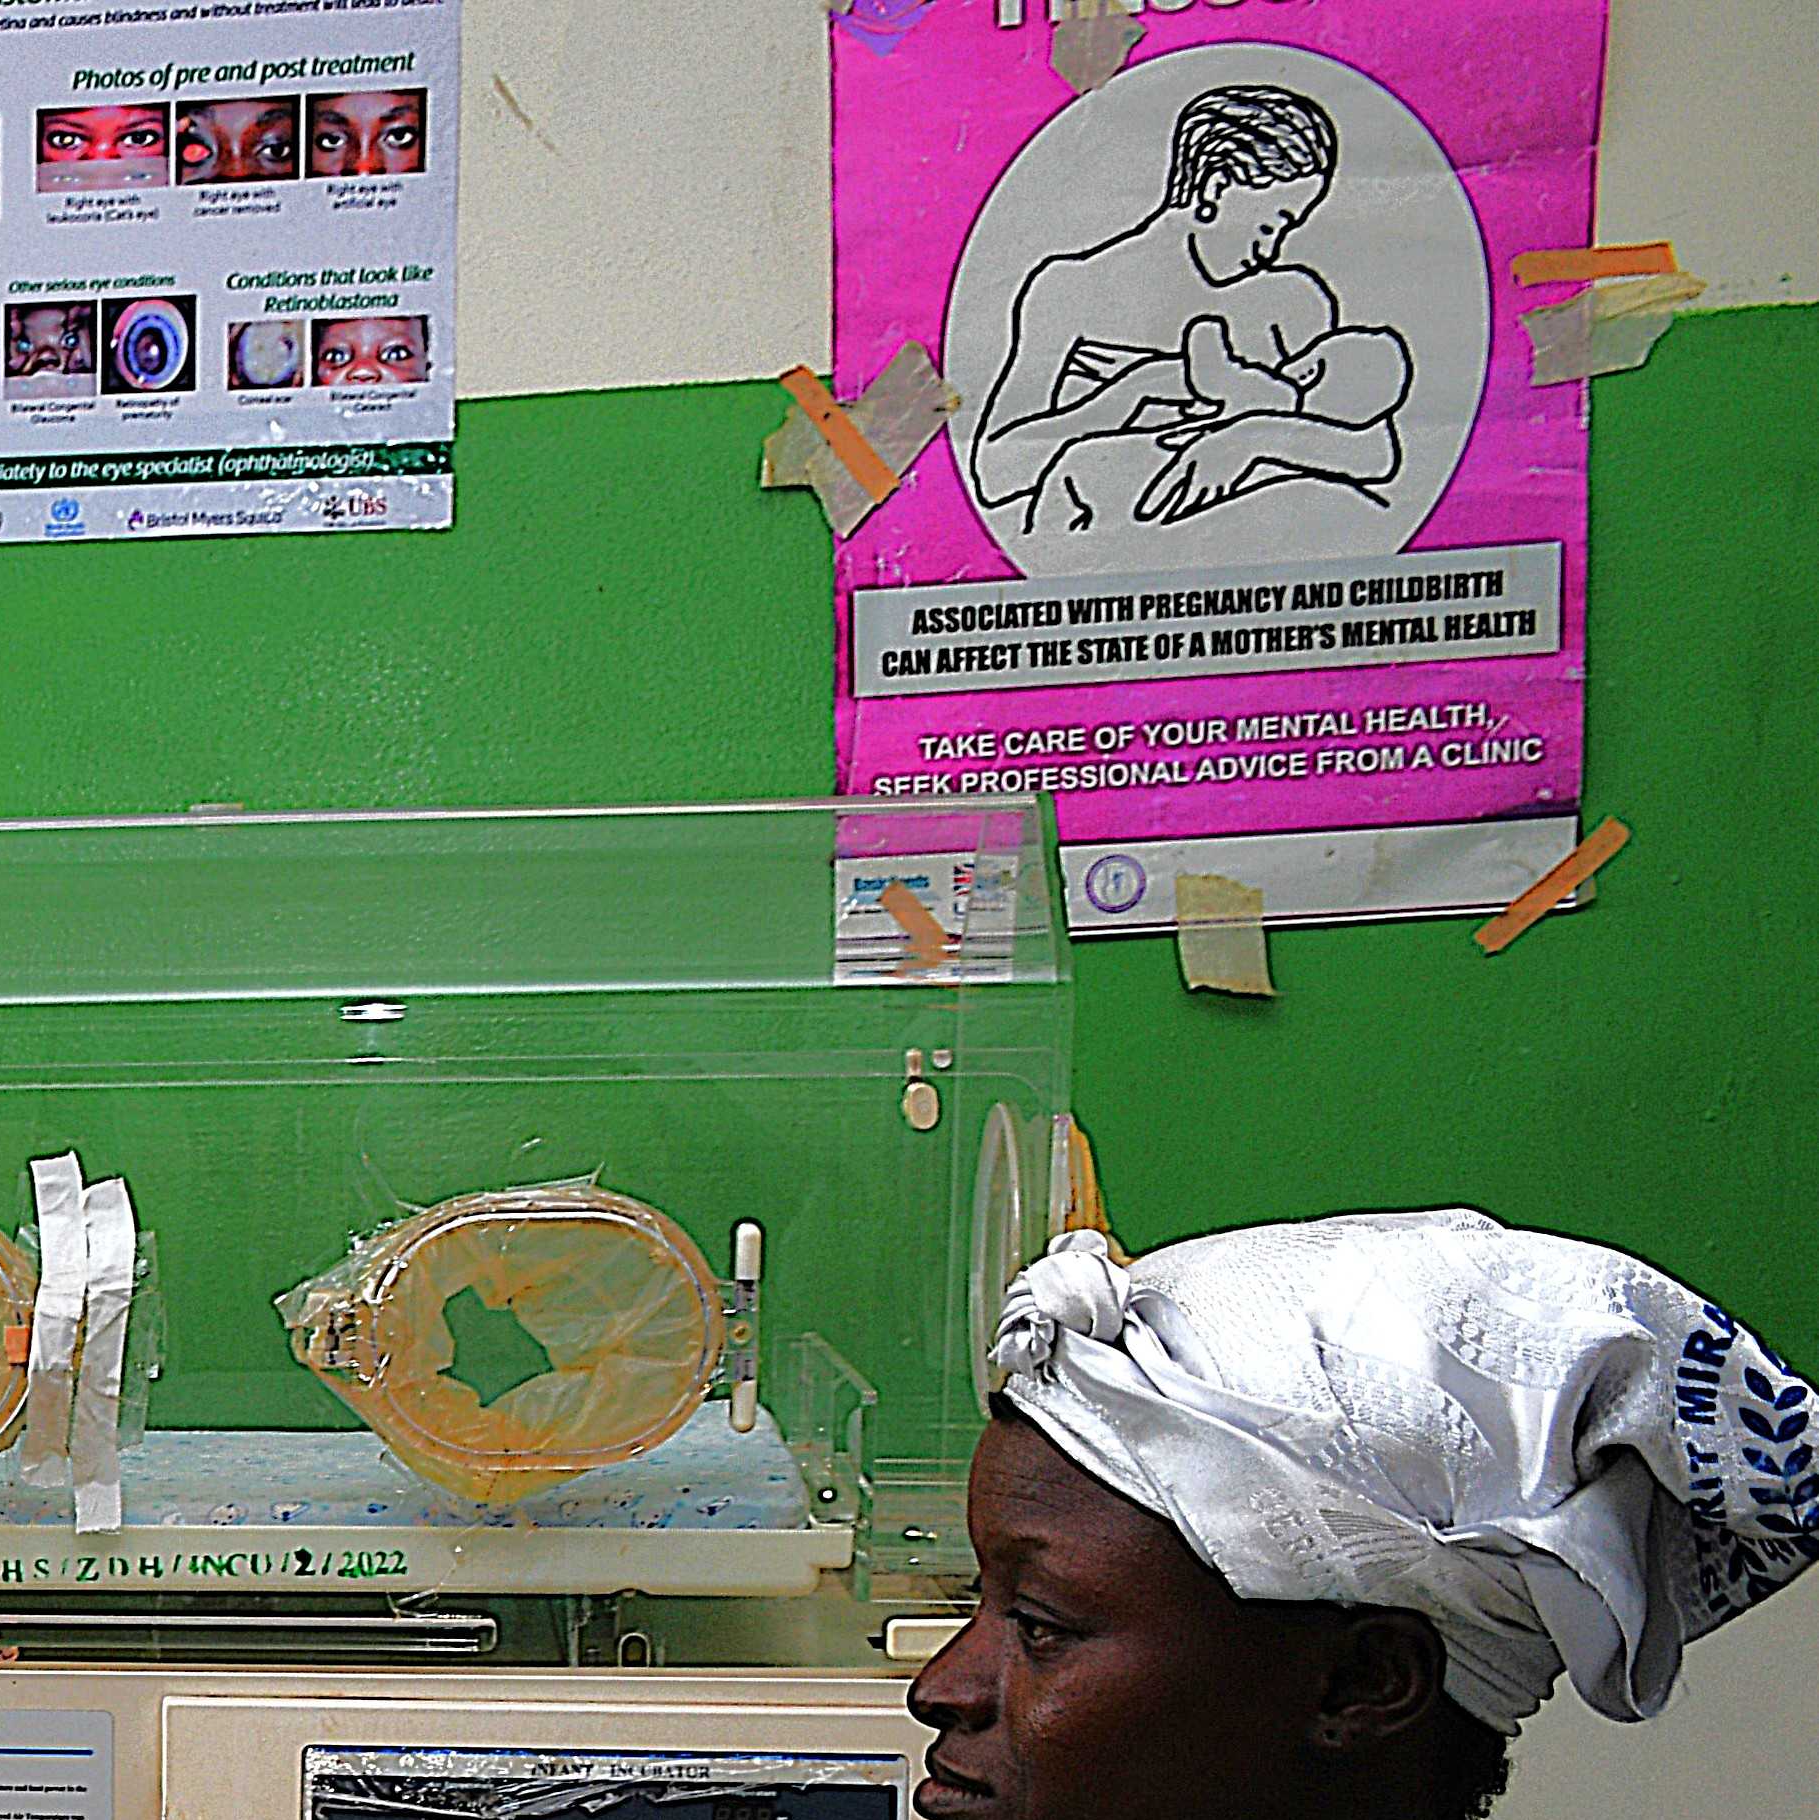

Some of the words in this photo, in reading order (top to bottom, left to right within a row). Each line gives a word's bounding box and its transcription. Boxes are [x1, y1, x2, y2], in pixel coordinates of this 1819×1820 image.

[28, 14, 56, 29] and
[57, 14, 103, 27] causes
[103, 10, 167, 24] blindness
[168, 6, 198, 20] and
[199, 3, 252, 18] without
[71, 69, 145, 90] Photos
[147, 62, 174, 91] of
[172, 66, 211, 91] pre
[213, 60, 258, 82] and
[258, 58, 307, 85] post
[311, 52, 415, 76] treatment
[8, 281, 43, 294] Other
[44, 280, 87, 292] serious
[88, 279, 111, 293] eye
[112, 275, 175, 288] conditions
[226, 271, 317, 290] Conditions
[319, 269, 356, 286] that
[358, 267, 398, 284] look
[400, 266, 433, 282] like
[263, 294, 398, 312] Retinoblastoma
[48, 462, 67, 479] to
[69, 461, 99, 478] the
[100, 462, 133, 481] eye
[134, 456, 214, 479] specialist
[911, 601, 1062, 634] ASSOCIATED
[1066, 595, 1134, 625] WITH
[1139, 586, 1287, 620] PREGNANCY
[1291, 582, 1344, 610] AND
[1349, 571, 1504, 606] CHILDBIRTH
[880, 649, 931, 677] CAN
[935, 643, 1022, 673] AFFECT
[1025, 640, 1072, 668] THE
[1076, 635, 1149, 665] STATE
[1152, 632, 1186, 660] OF
[1188, 631, 1207, 658] A
[1210, 623, 1336, 656] MOTHER'S
[1340, 617, 1439, 647] MENTAL
[1443, 610, 1536, 641] HEALTH
[918, 734, 996, 759] TAKE
[1002, 728, 1087, 755] CARE
[1093, 725, 1136, 749] OF
[1142, 720, 1227, 746] YOUR
[1235, 713, 1358, 740] MENTAL
[962, 762, 1190, 793] PROFESSIONAL
[1195, 753, 1308, 780] ADVICE
[1315, 747, 1405, 774] FROM
[1410, 745, 1434, 768] A
[1440, 738, 1544, 766] CLINIC
